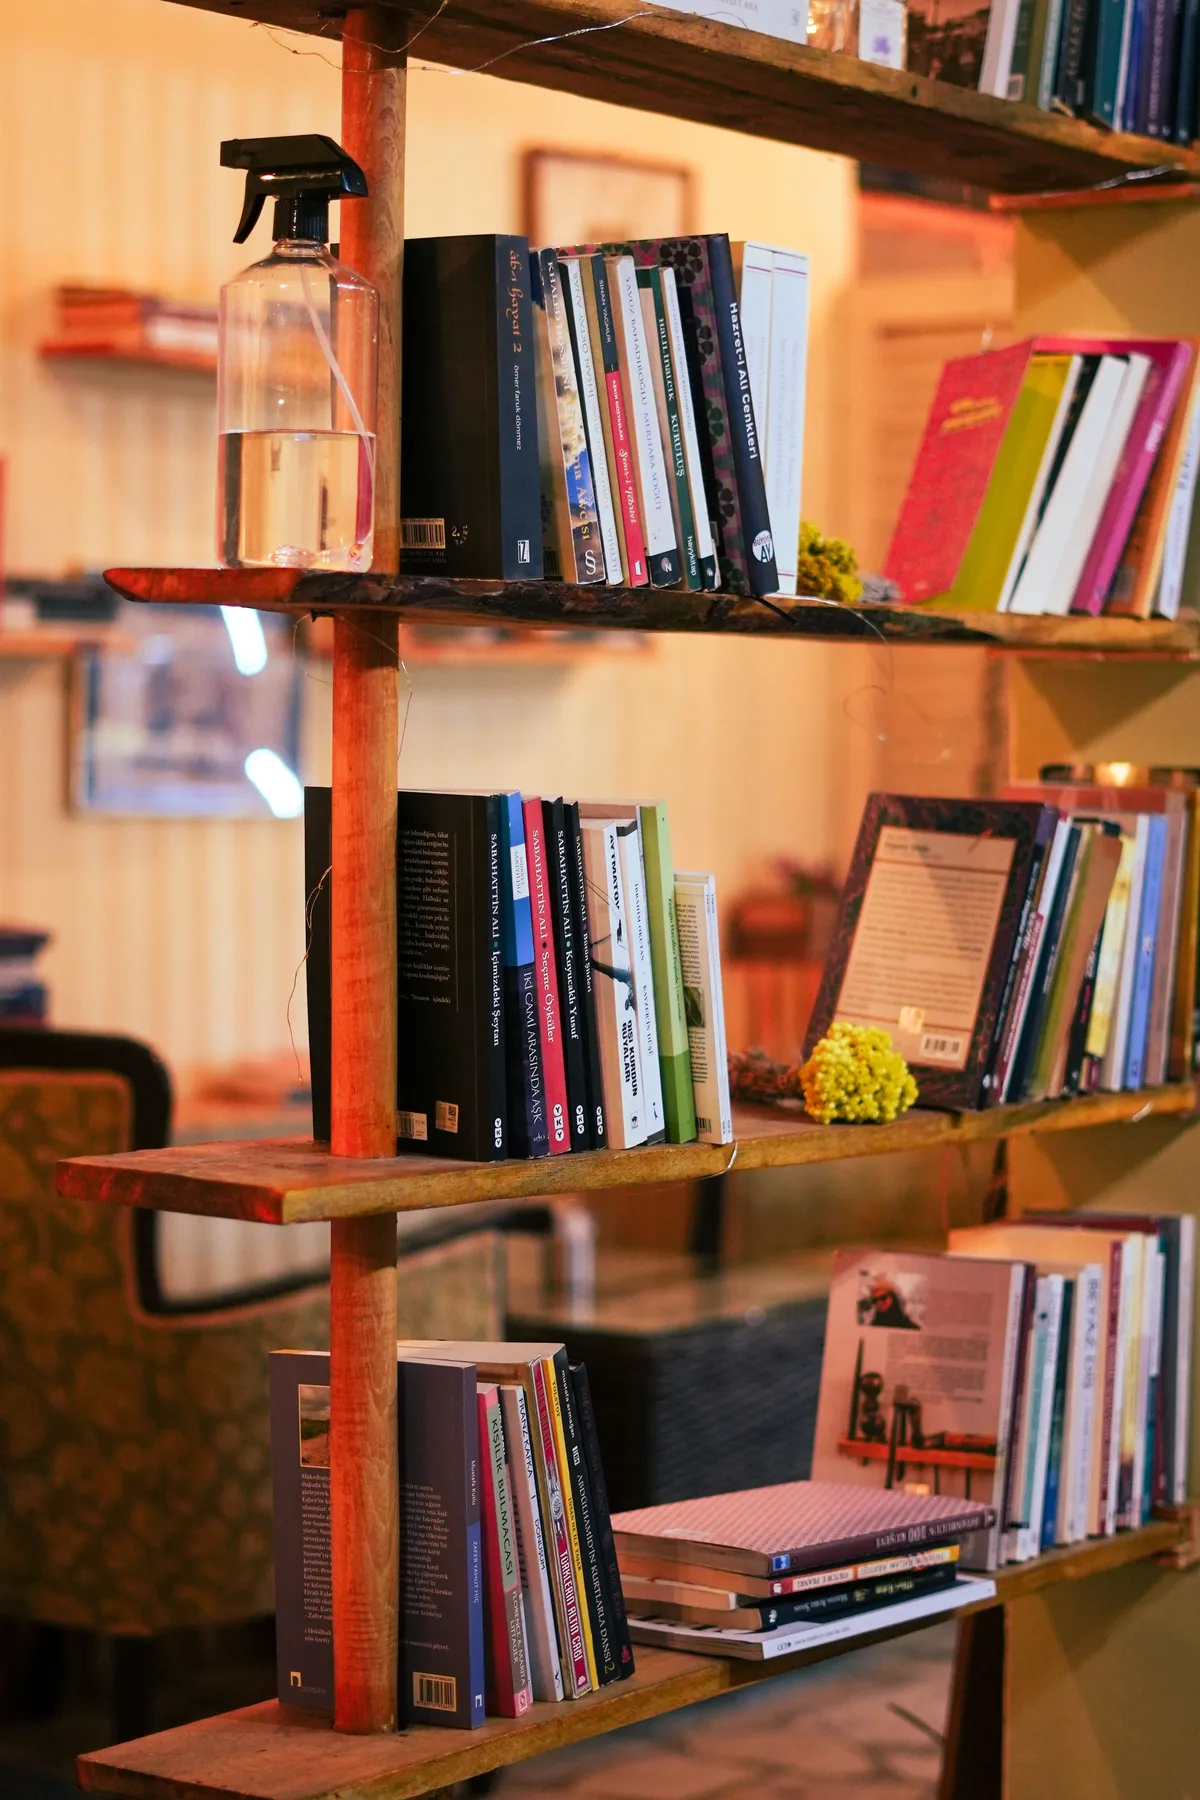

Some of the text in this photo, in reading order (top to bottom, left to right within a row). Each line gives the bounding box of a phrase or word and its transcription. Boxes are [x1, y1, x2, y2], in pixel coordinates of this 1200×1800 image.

[547, 261, 561, 321] KHALED
[506, 287, 523, 337] hayat
[513, 343, 522, 354] 2
[513, 365, 521, 388] ömer
[514, 390, 522, 413] faruk
[670, 413, 685, 478] KURULUŞ
[742, 394, 758, 460] Cenkleri
[686, 535, 698, 577] hayykitap
[609, 834, 621, 911] AYTMATOV
[490, 833, 502, 1047] SABAHATTİN ALİ İçimizdeki Şeytan
[532, 829, 555, 1043] SABAHATTİN ALİ Seçme Öyküler
[557, 829, 579, 1040] SABAHATTİN ALİ Kuyucaklı Yusuf
[524, 991, 537, 1028] CAMİ
[526, 1030, 541, 1098] ARASINDA
[629, 1048, 638, 1097] KURDUN
[530, 1098, 543, 1125] AŞK
[551, 1380, 561, 1418] TOLSTOY
[561, 1370, 570, 1403] mustafa
[518, 1397, 529, 1435] FRANZ
[470, 1461, 478, 1487] Mustafa
[496, 1478, 514, 1576] BULMACASI
[472, 1541, 480, 1563] ZAFER
[591, 1565, 607, 1625] KURTLARLA
[566, 1606, 580, 1635] ALTIN
[601, 1628, 613, 1662] DANSI
[603, 1662, 616, 1675] 2
